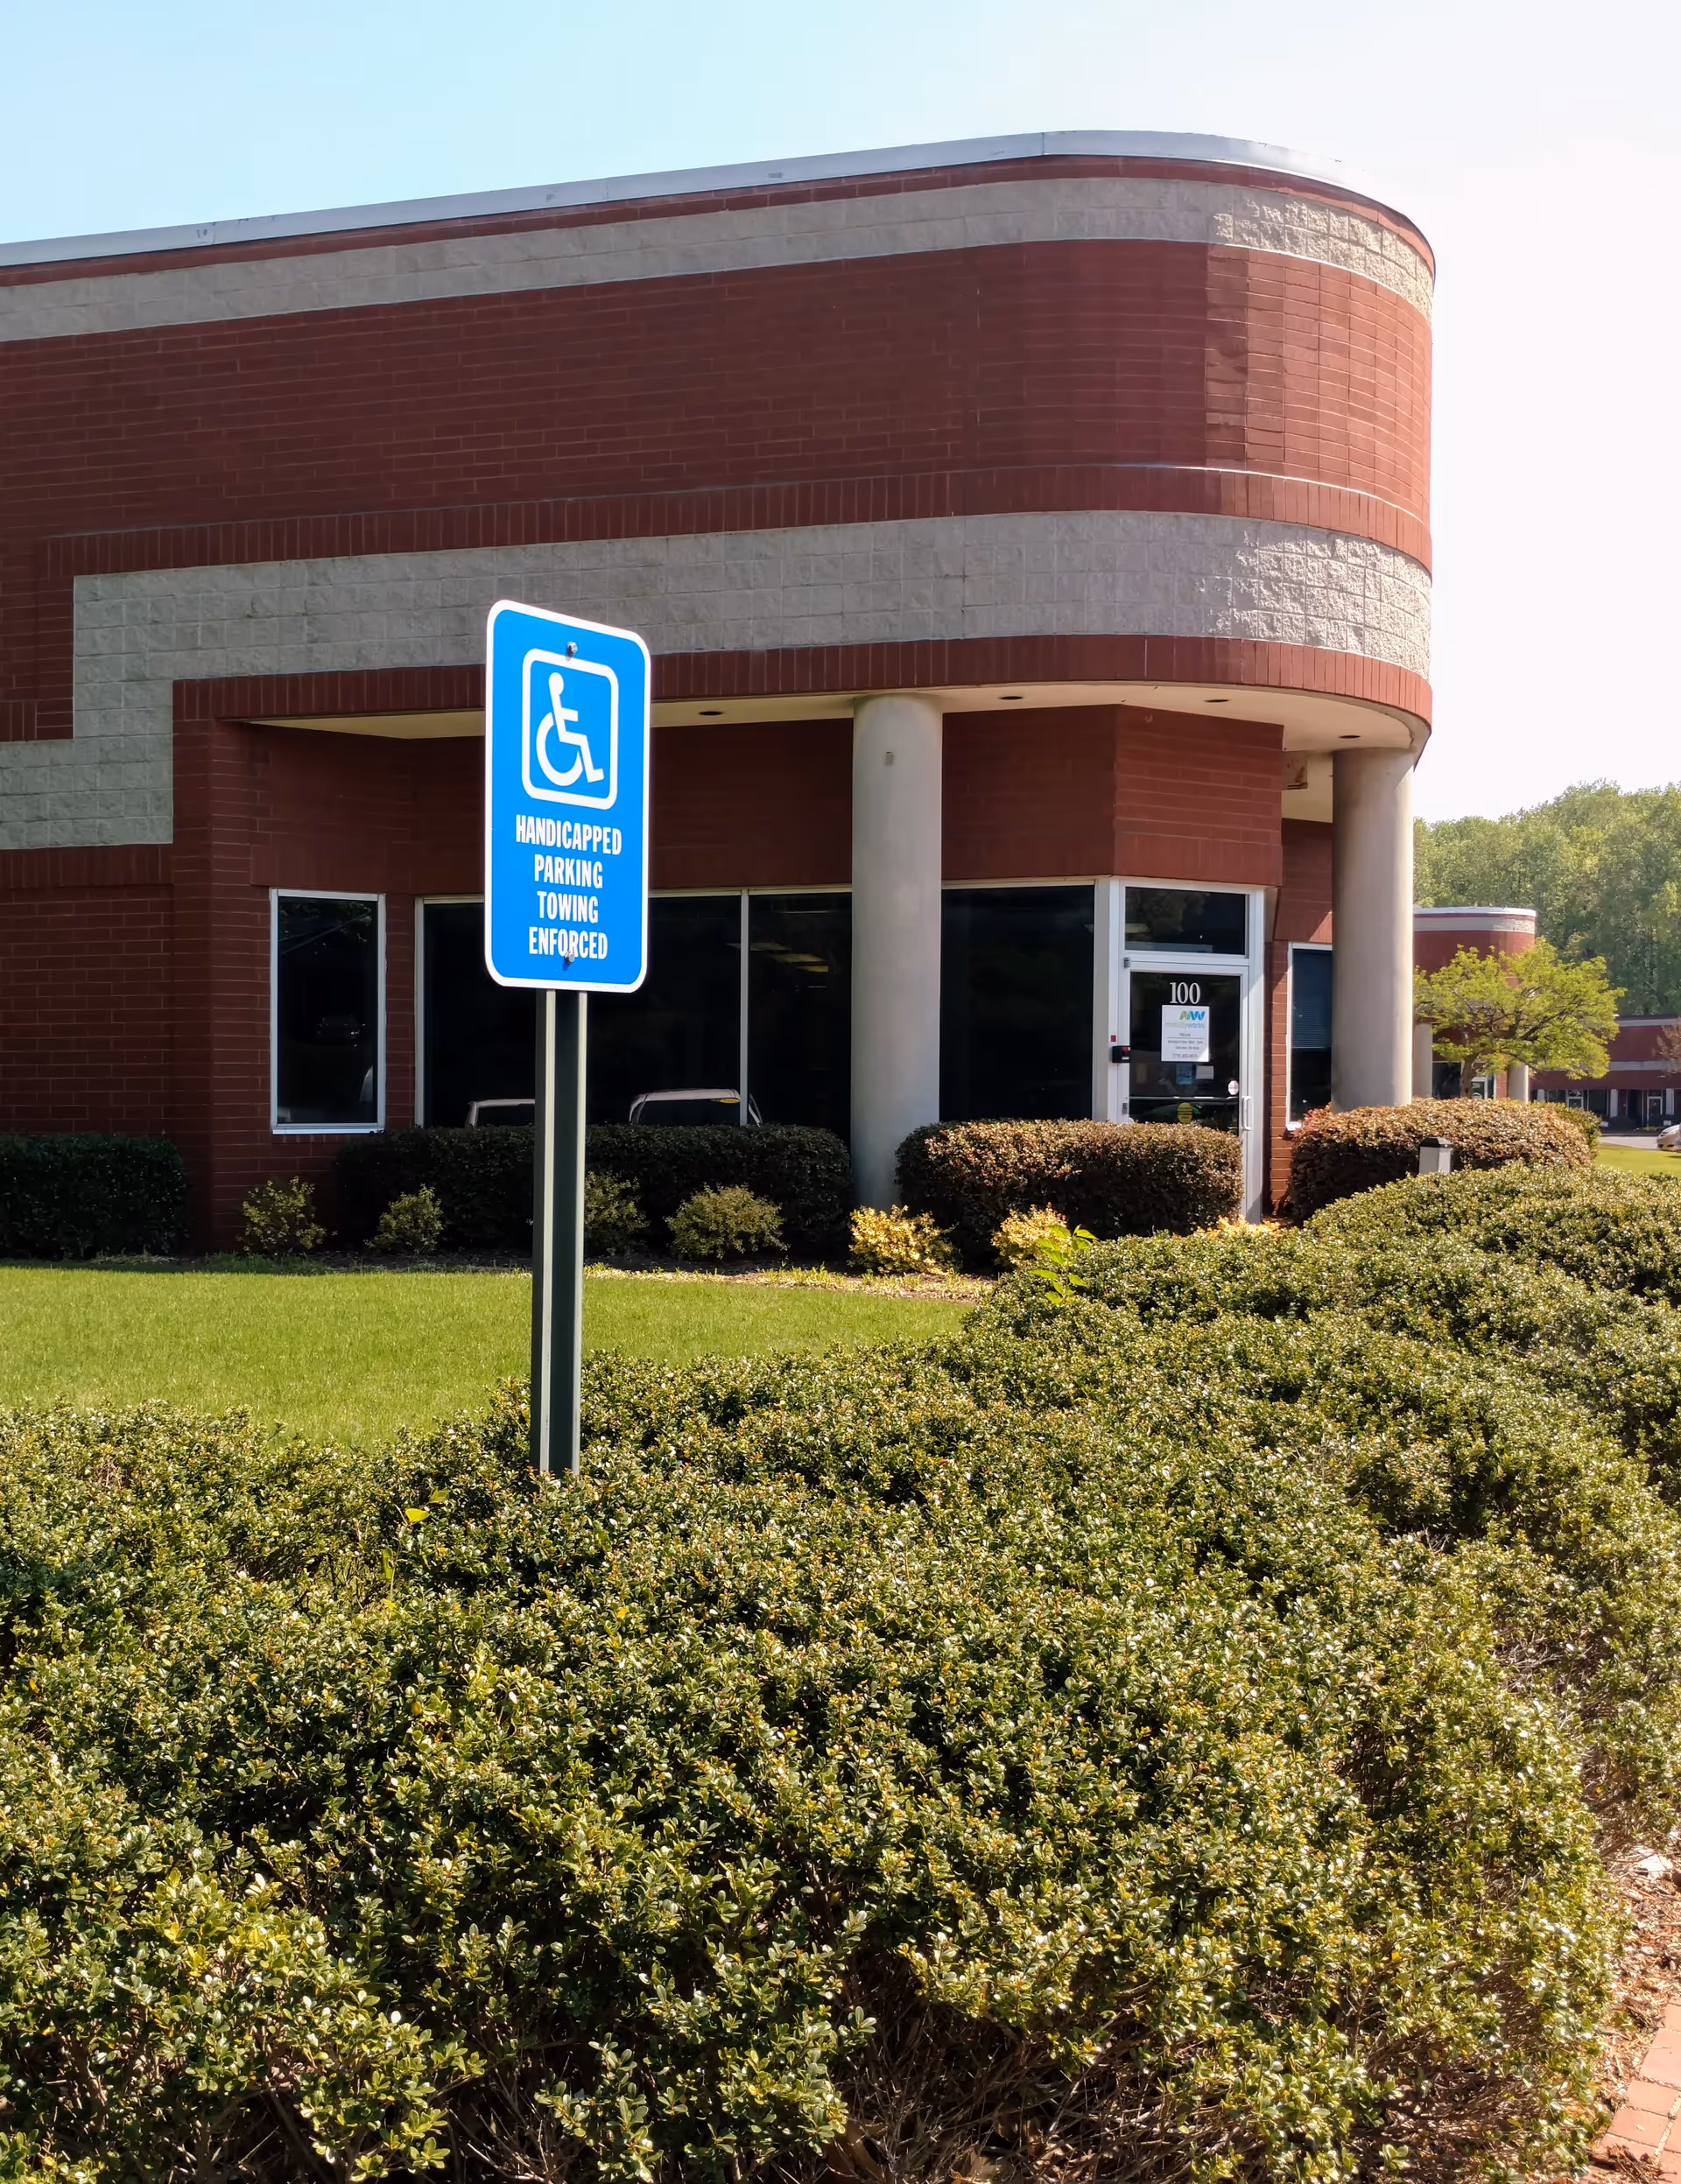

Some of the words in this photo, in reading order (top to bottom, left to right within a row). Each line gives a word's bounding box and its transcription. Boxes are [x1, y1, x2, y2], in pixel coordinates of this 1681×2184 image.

[516, 814, 622, 855] HANDICAPPED
[534, 854, 603, 888] PARKING
[537, 890, 599, 923] TOWING
[528, 926, 608, 959] ENFORCED
[1170, 981, 1200, 1004] 100
